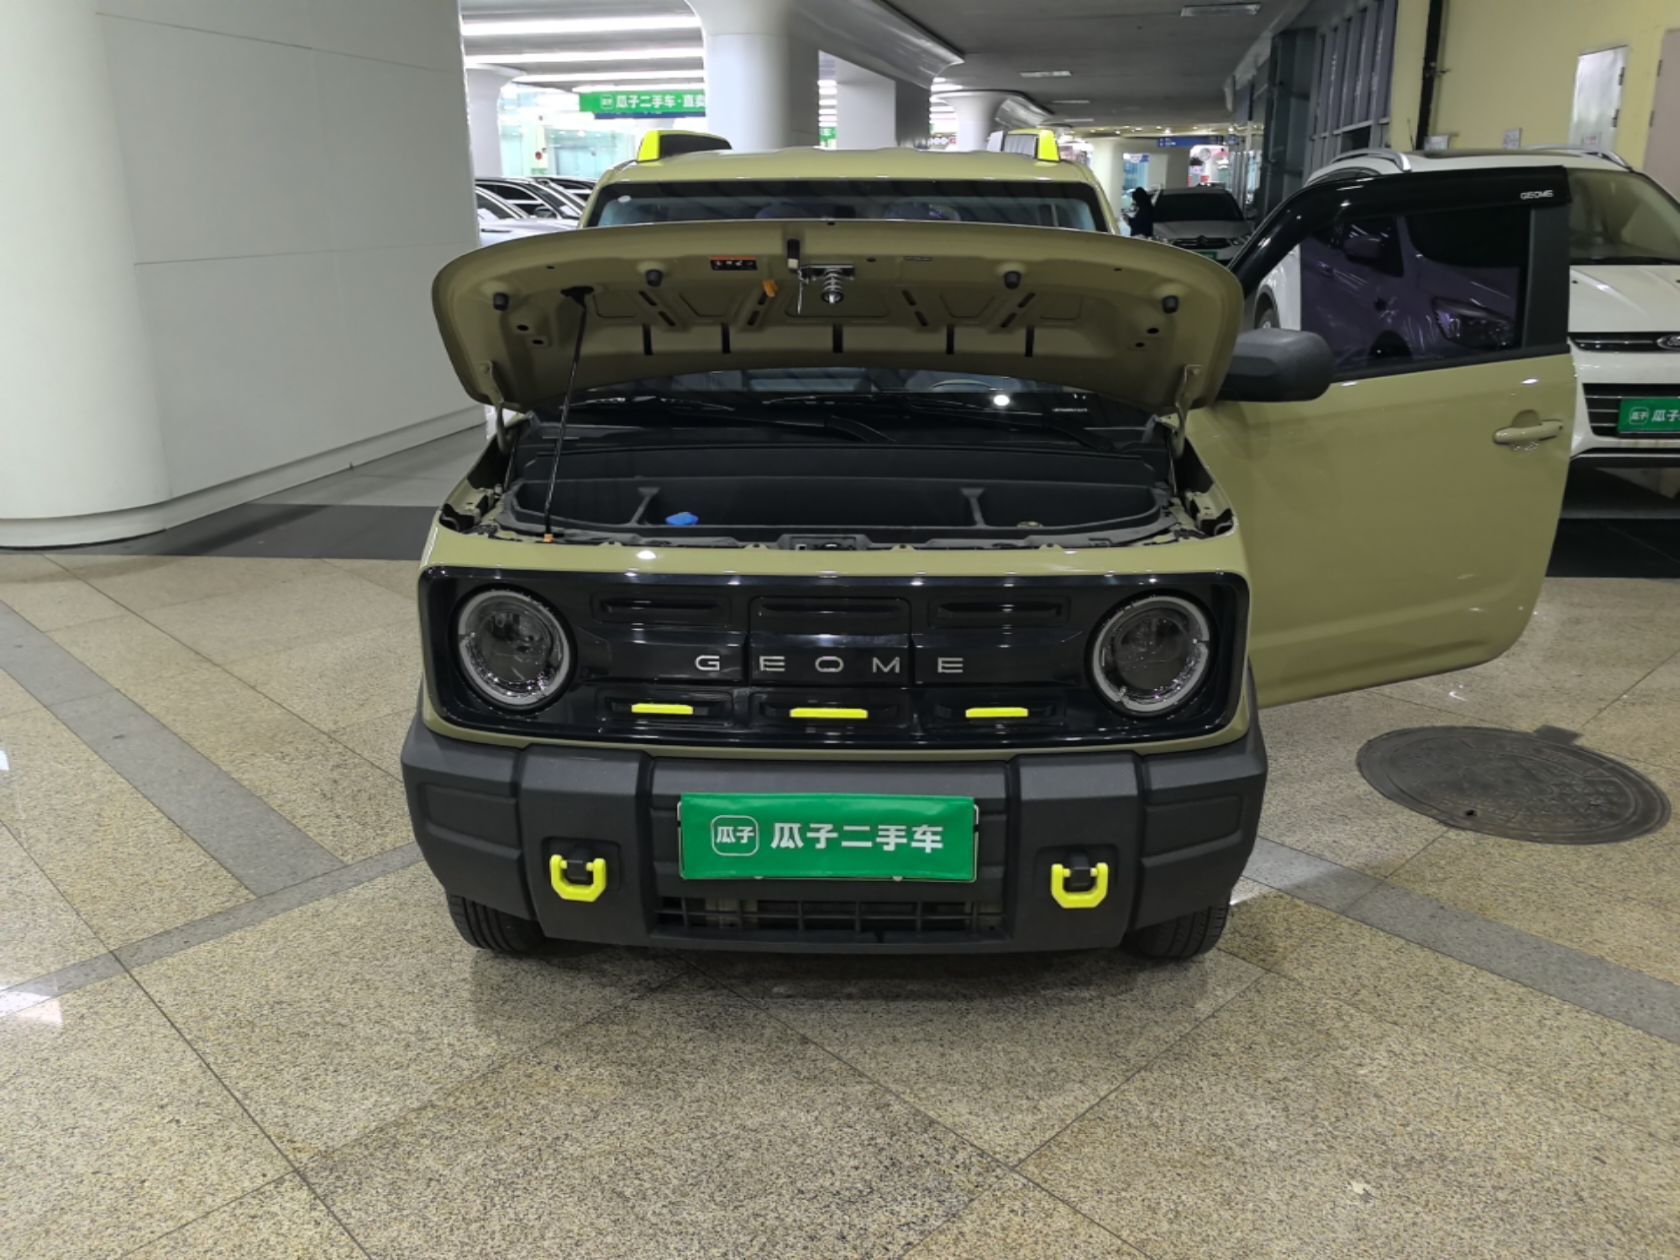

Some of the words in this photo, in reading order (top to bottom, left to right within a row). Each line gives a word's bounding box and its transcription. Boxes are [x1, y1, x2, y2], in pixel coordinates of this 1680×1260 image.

[1651, 409, 1680, 423] 瓜子
[695, 655, 964, 674] GEOME
[716, 826, 755, 844] 瓜子
[770, 822, 944, 854] 瓜子二手车
